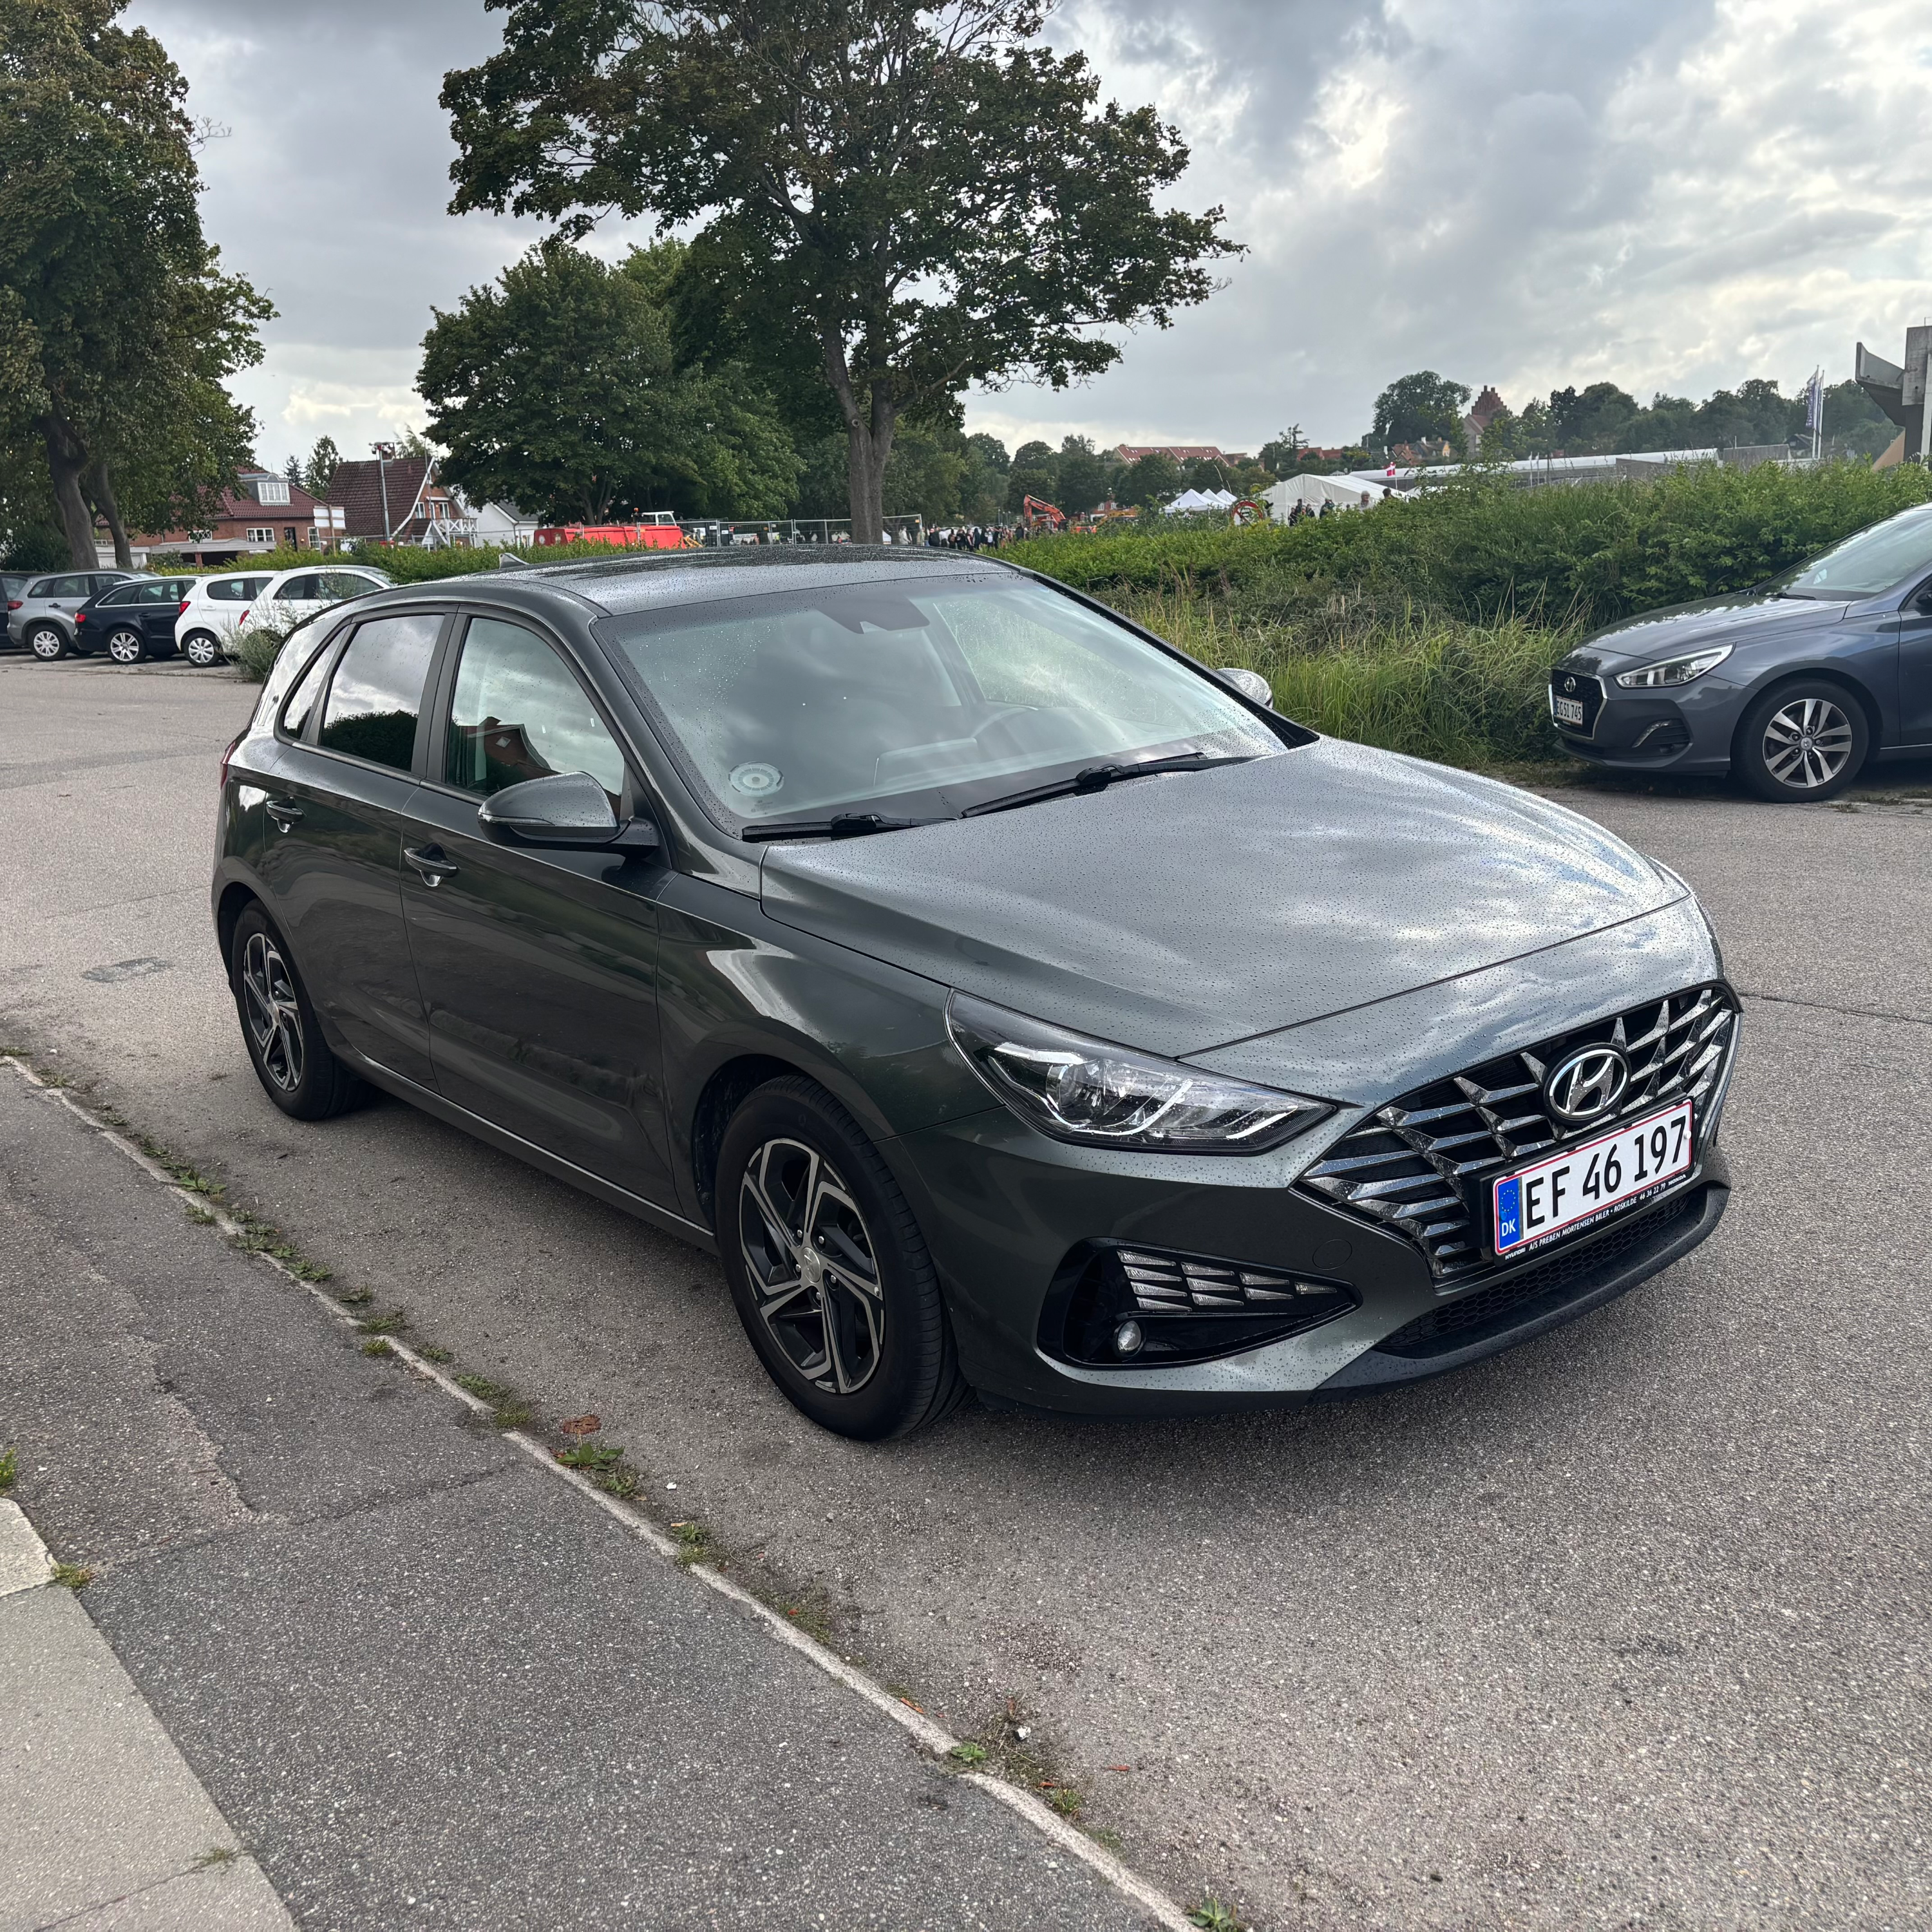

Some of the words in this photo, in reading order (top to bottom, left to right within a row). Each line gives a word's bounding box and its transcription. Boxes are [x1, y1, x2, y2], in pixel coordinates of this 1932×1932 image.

[1557, 701, 1563, 716] EG
[1564, 703, 1569, 717] 51
[1571, 705, 1582, 721] 745
[1526, 1166, 1570, 1229] EF
[1582, 1144, 1622, 1200] 46
[1634, 1115, 1686, 1182] 197
[1501, 1218, 1516, 1236] DK
[1505, 1247, 1526, 1260] HYUNDAI
[1539, 1231, 1560, 1247] PREBEN
[1561, 1217, 1595, 1237] MORTENSEN
[1595, 1209, 1609, 1222] BILER
[1614, 1197, 1637, 1213] ROSKILDE
[1640, 1192, 1645, 1200] 46
[1653, 1186, 1659, 1194] 22
